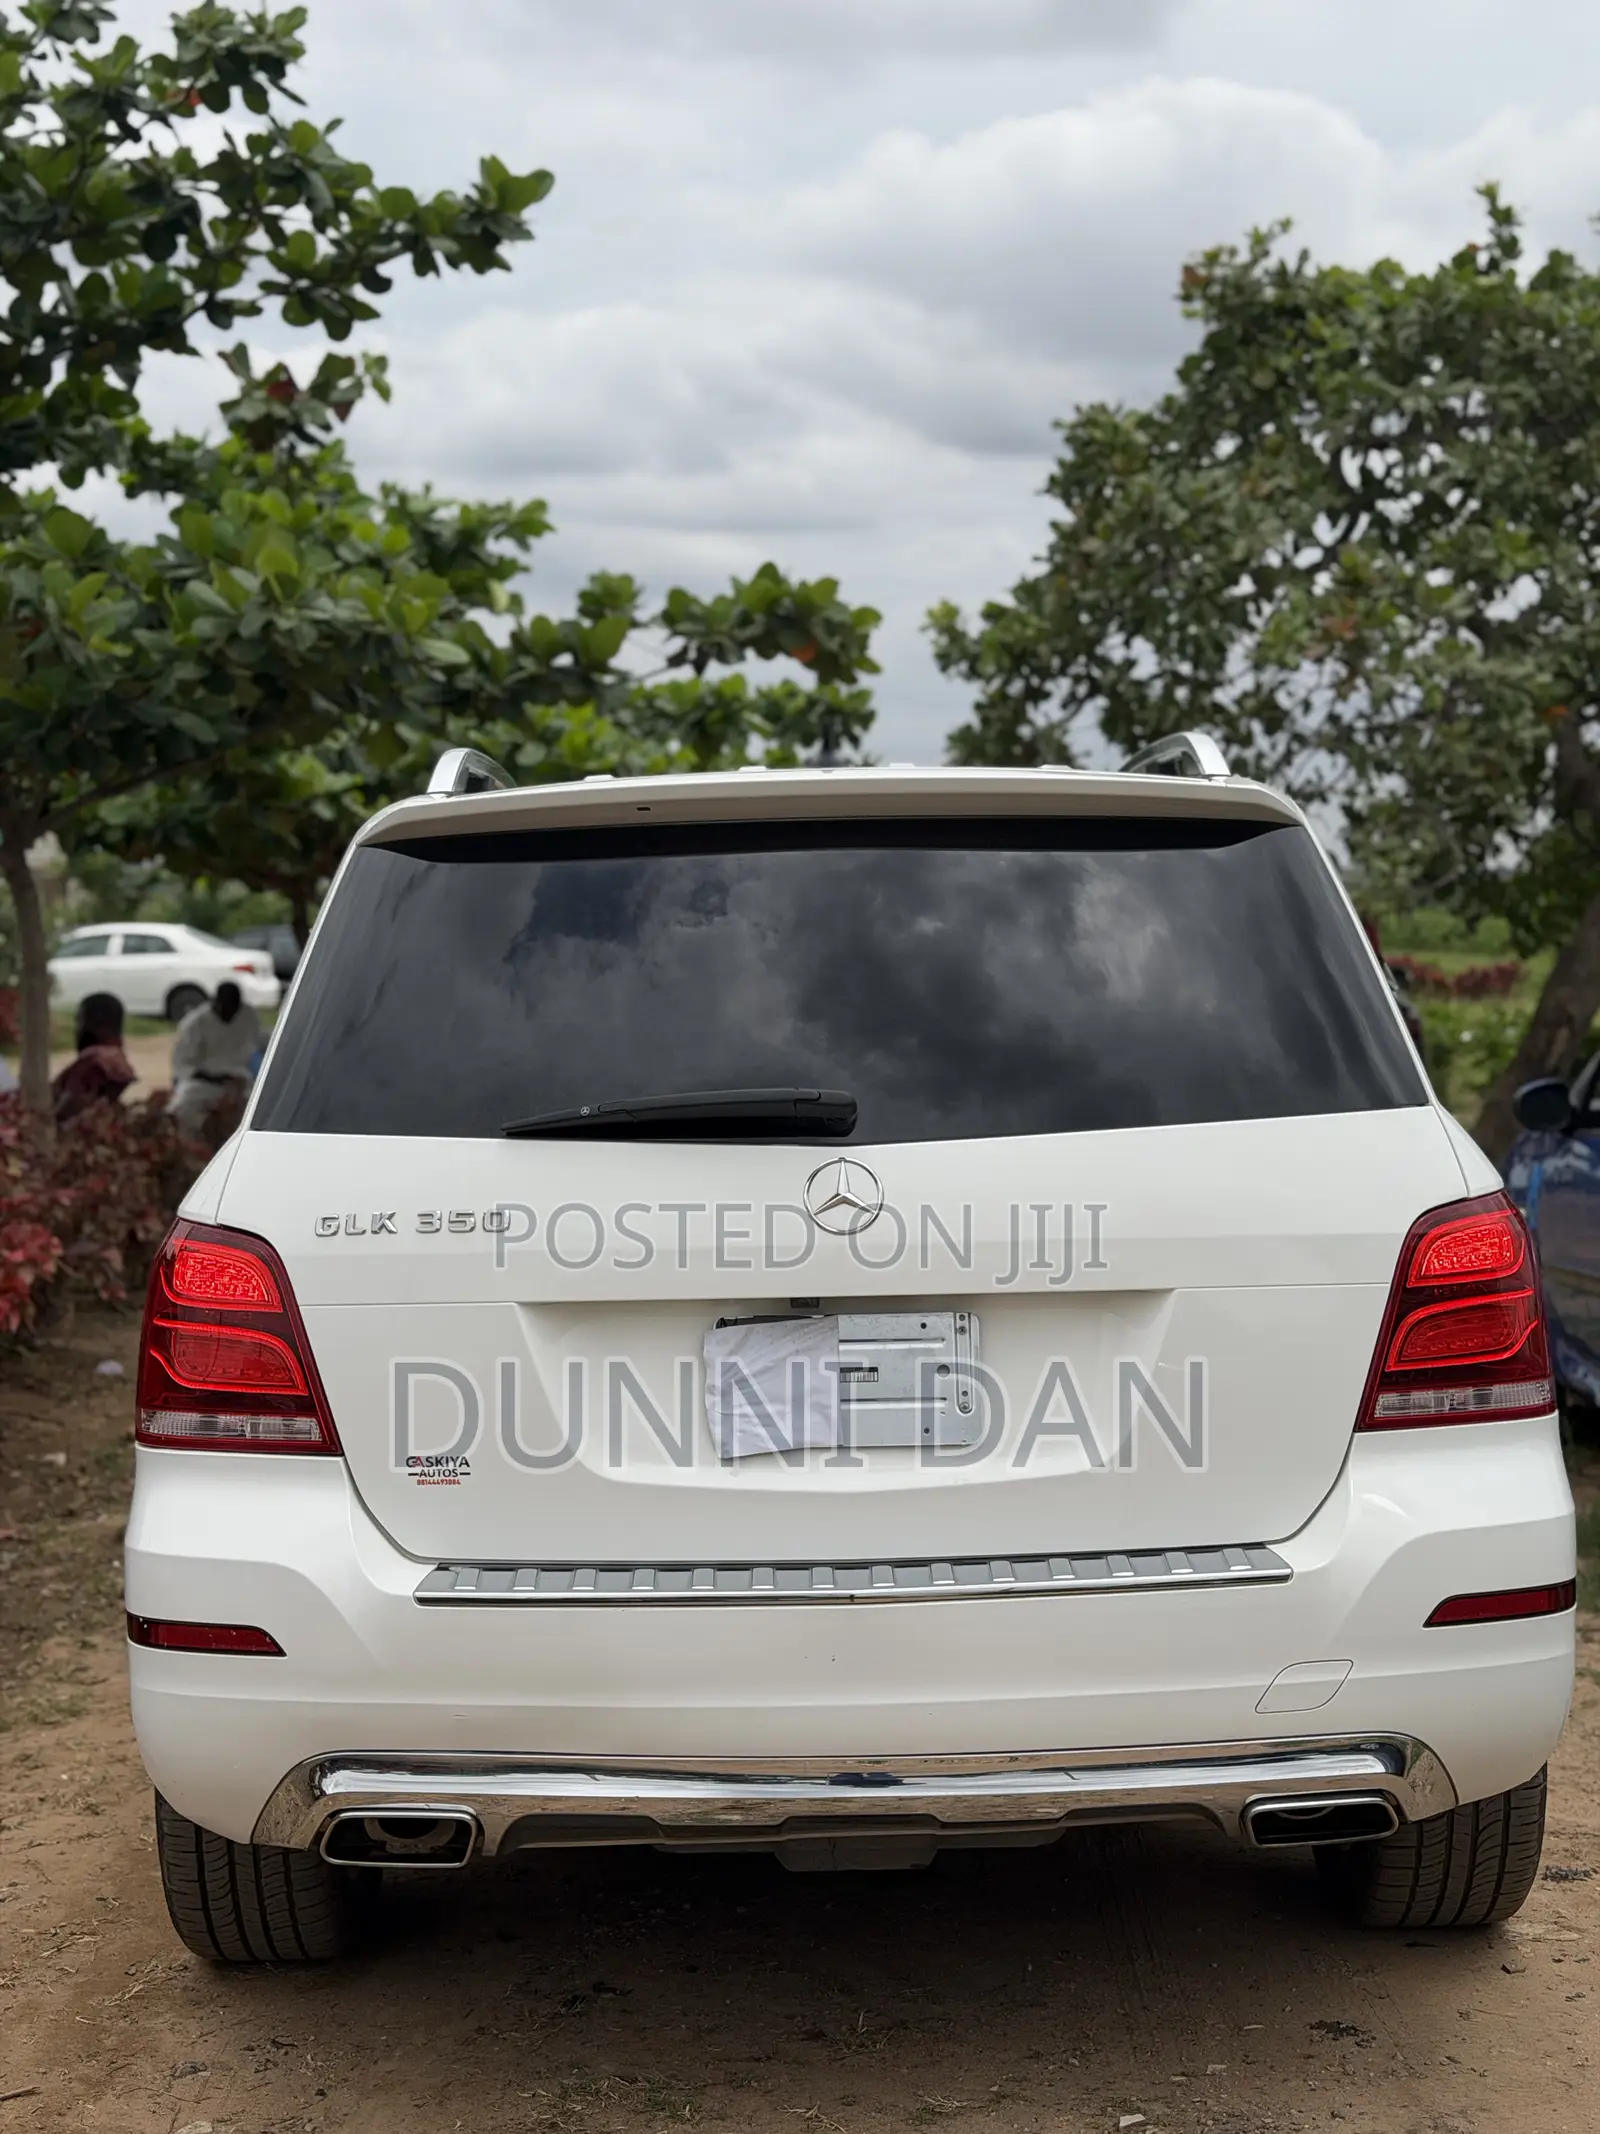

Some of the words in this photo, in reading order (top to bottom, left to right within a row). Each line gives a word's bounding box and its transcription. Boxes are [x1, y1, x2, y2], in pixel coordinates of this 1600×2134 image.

[314, 1210, 399, 1238] GLK
[415, 1207, 512, 1234] 350
[405, 1455, 471, 1468] GASKIYA
[418, 1468, 459, 1478] AUTOS
